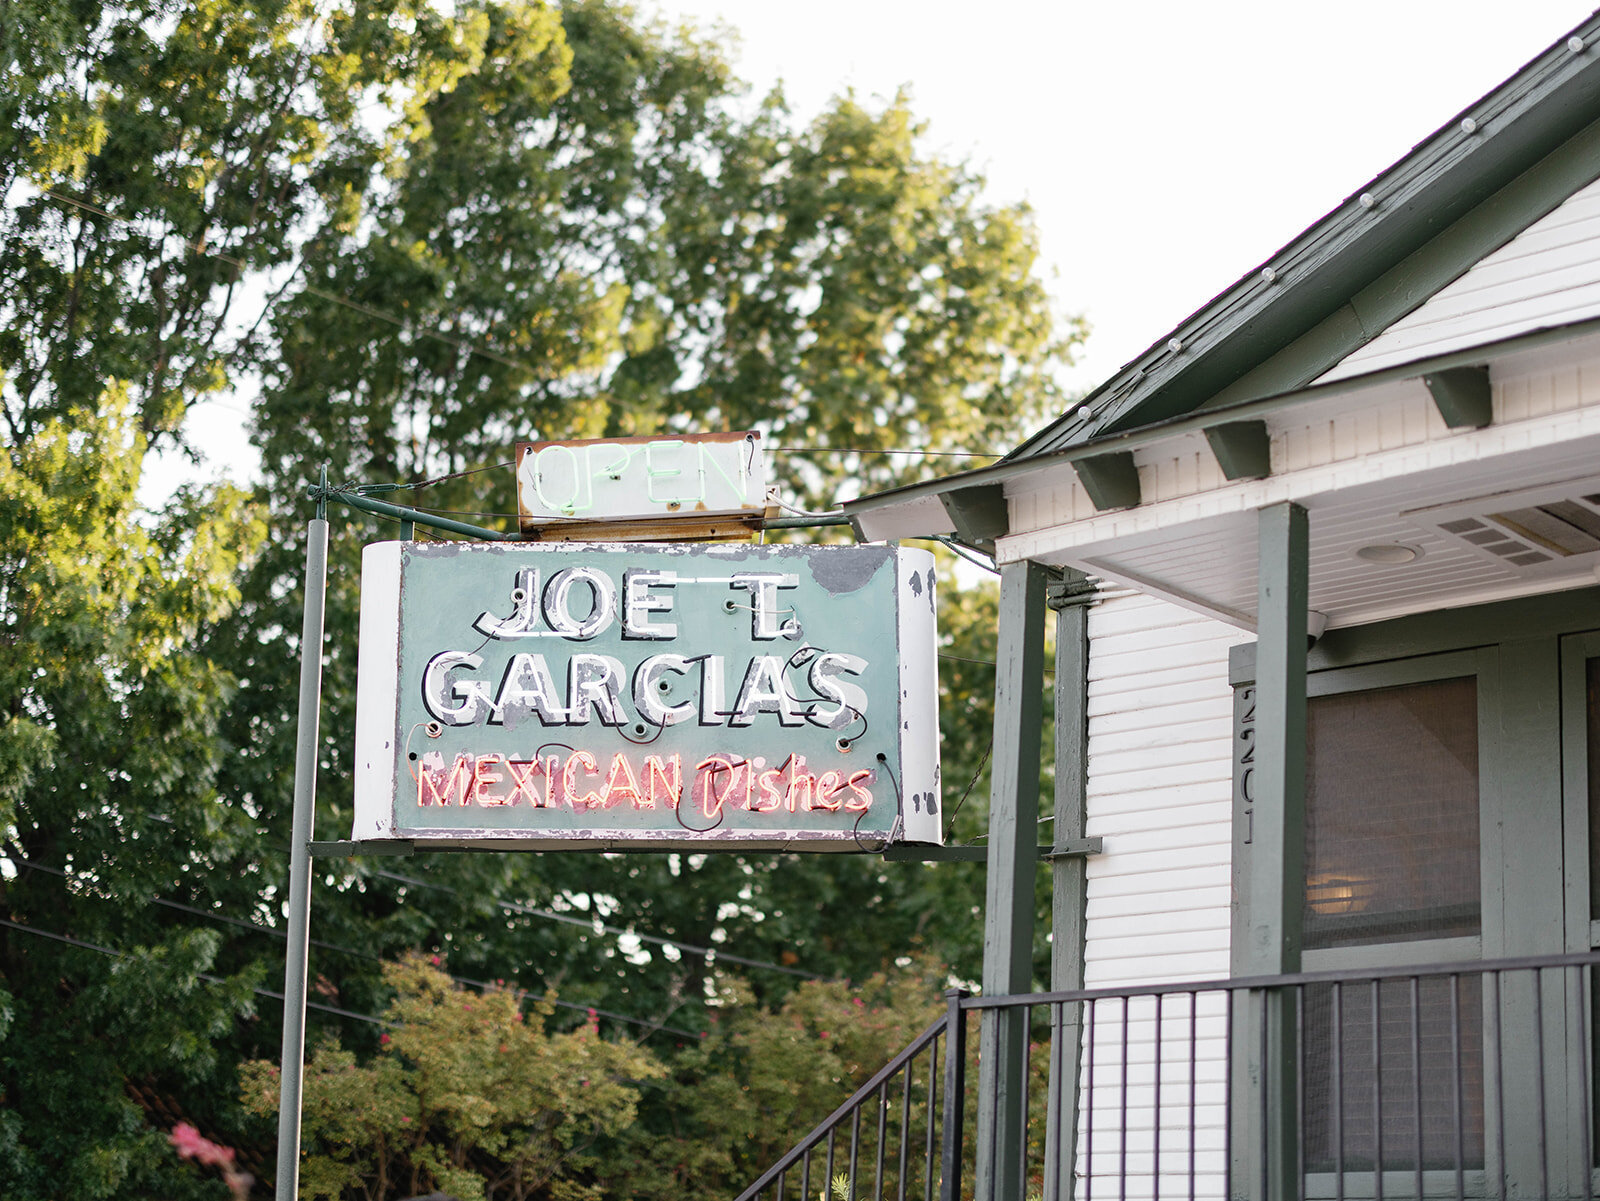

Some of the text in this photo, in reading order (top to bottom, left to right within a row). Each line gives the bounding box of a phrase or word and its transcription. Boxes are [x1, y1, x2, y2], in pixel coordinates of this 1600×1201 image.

[534, 440, 747, 511] OPEN
[471, 566, 678, 642] JOE
[421, 641, 869, 731] GARCIA'S
[417, 751, 683, 815] MEXICAN
